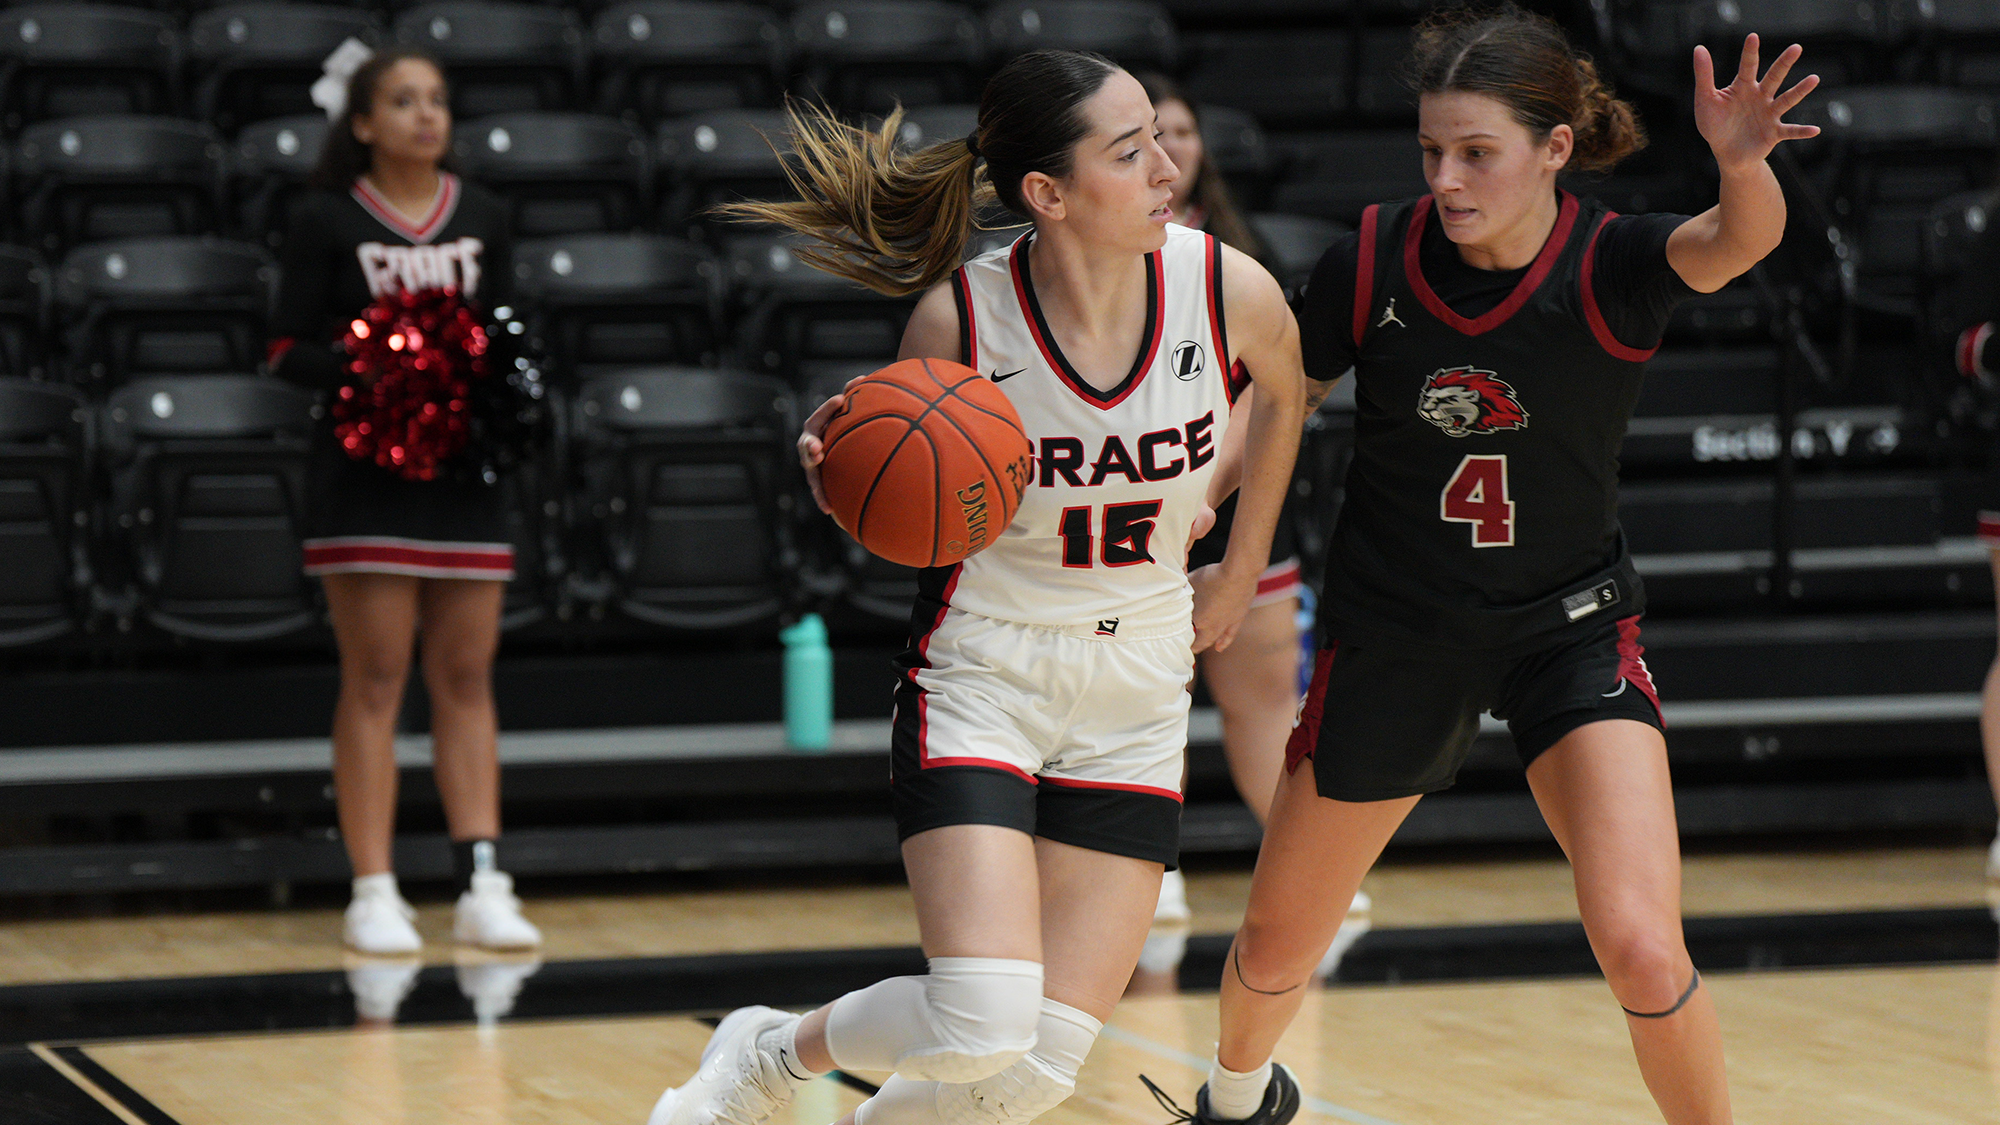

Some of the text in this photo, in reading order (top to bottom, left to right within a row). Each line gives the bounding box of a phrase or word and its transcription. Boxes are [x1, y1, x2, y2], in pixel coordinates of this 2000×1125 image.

[1026, 410, 1214, 488] RACE
[1058, 498, 1163, 569] 15
[1440, 454, 1515, 548] 4
[1602, 588, 1613, 601] S
